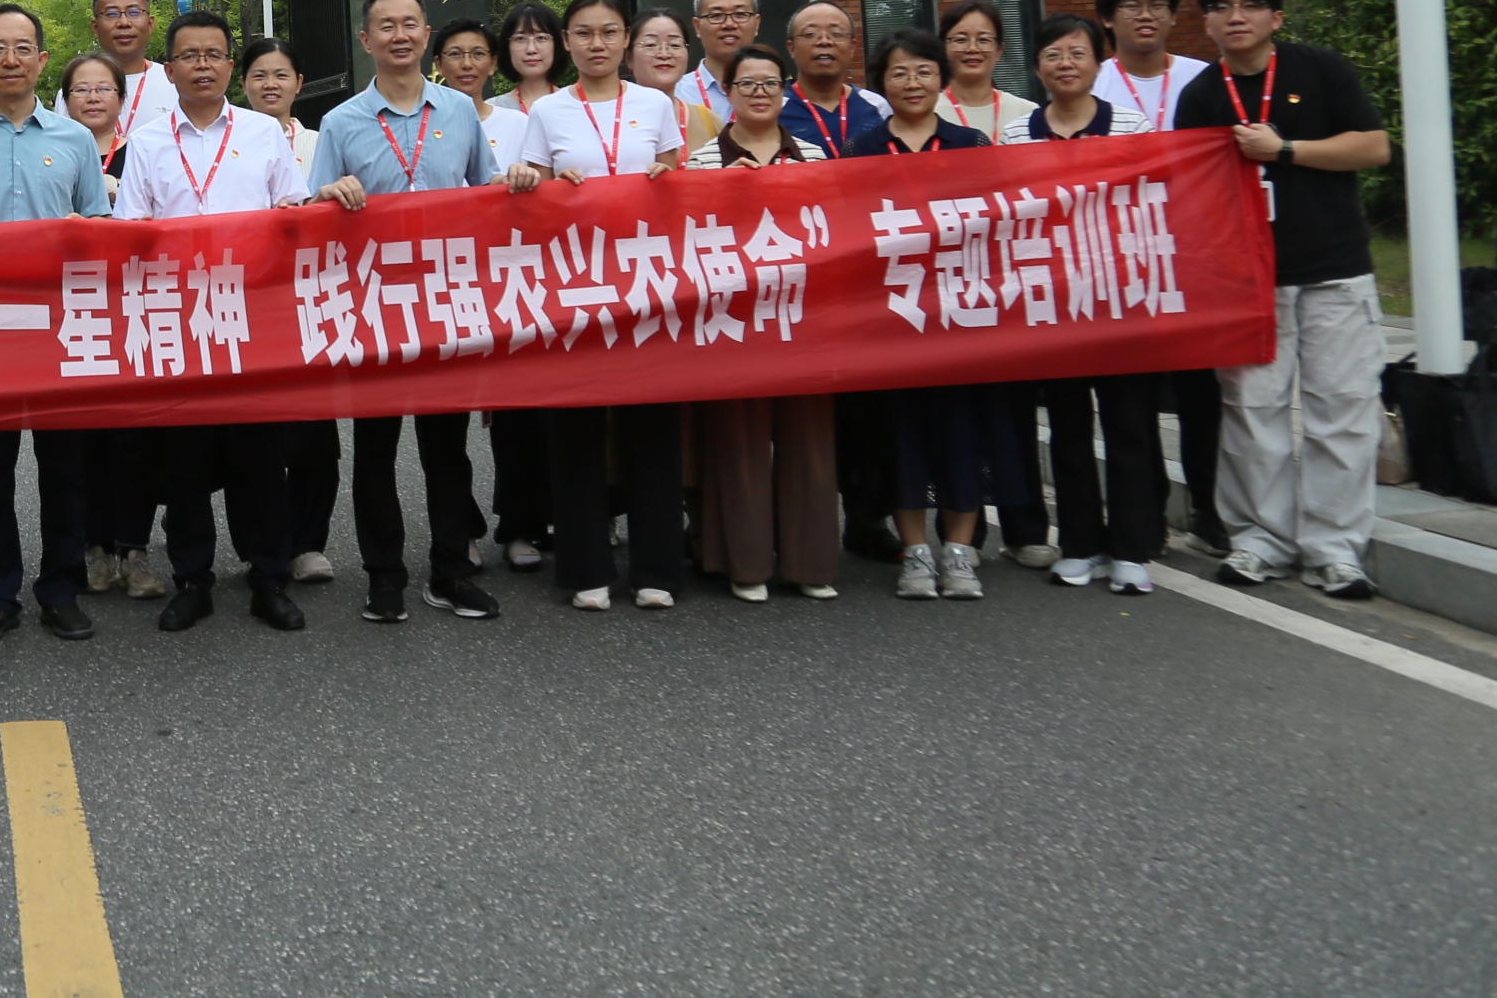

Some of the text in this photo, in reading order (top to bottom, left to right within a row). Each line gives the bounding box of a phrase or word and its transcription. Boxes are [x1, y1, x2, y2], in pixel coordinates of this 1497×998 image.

[871, 176, 1186, 334] 专题培训班
